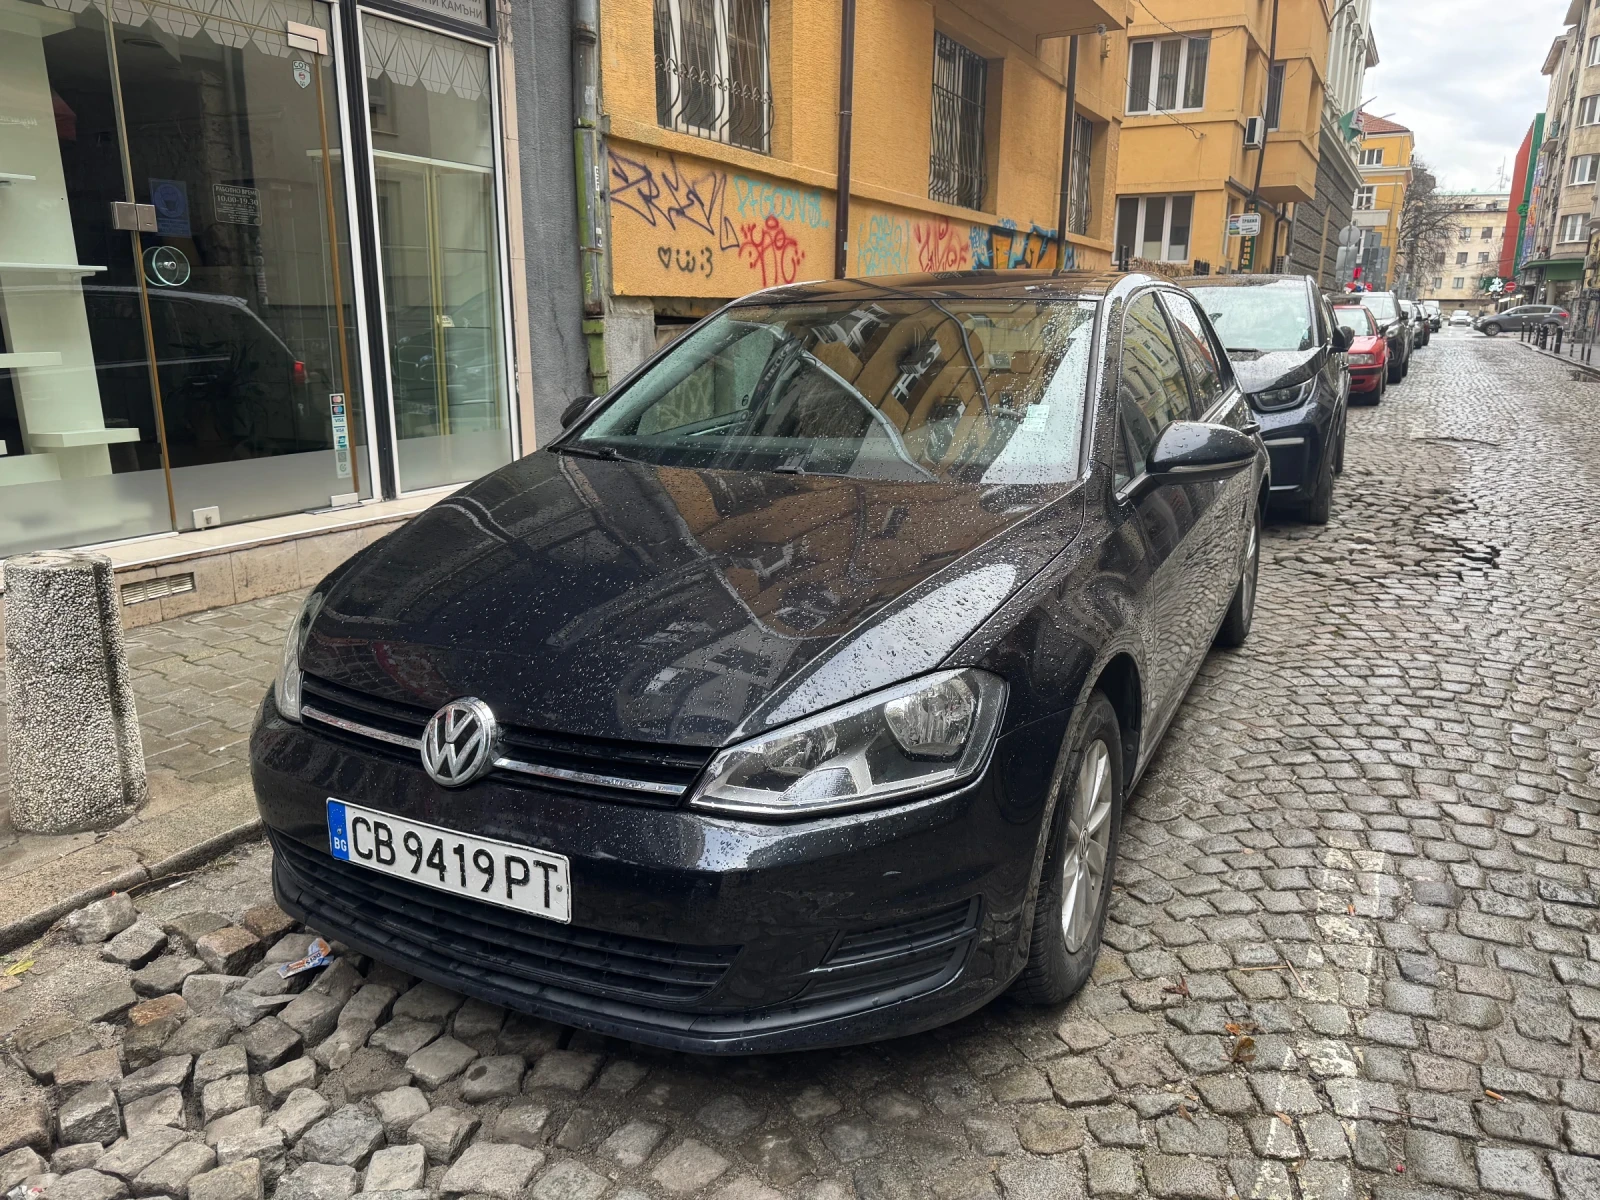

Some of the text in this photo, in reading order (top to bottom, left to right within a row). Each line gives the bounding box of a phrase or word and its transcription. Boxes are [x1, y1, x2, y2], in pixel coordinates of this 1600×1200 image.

[441, 0, 483, 19] КАМЪНИ
[215, 186, 241, 194] РАБОТНО
[217, 195, 258, 205] 10.00-19.30
[333, 836, 348, 852] BG
